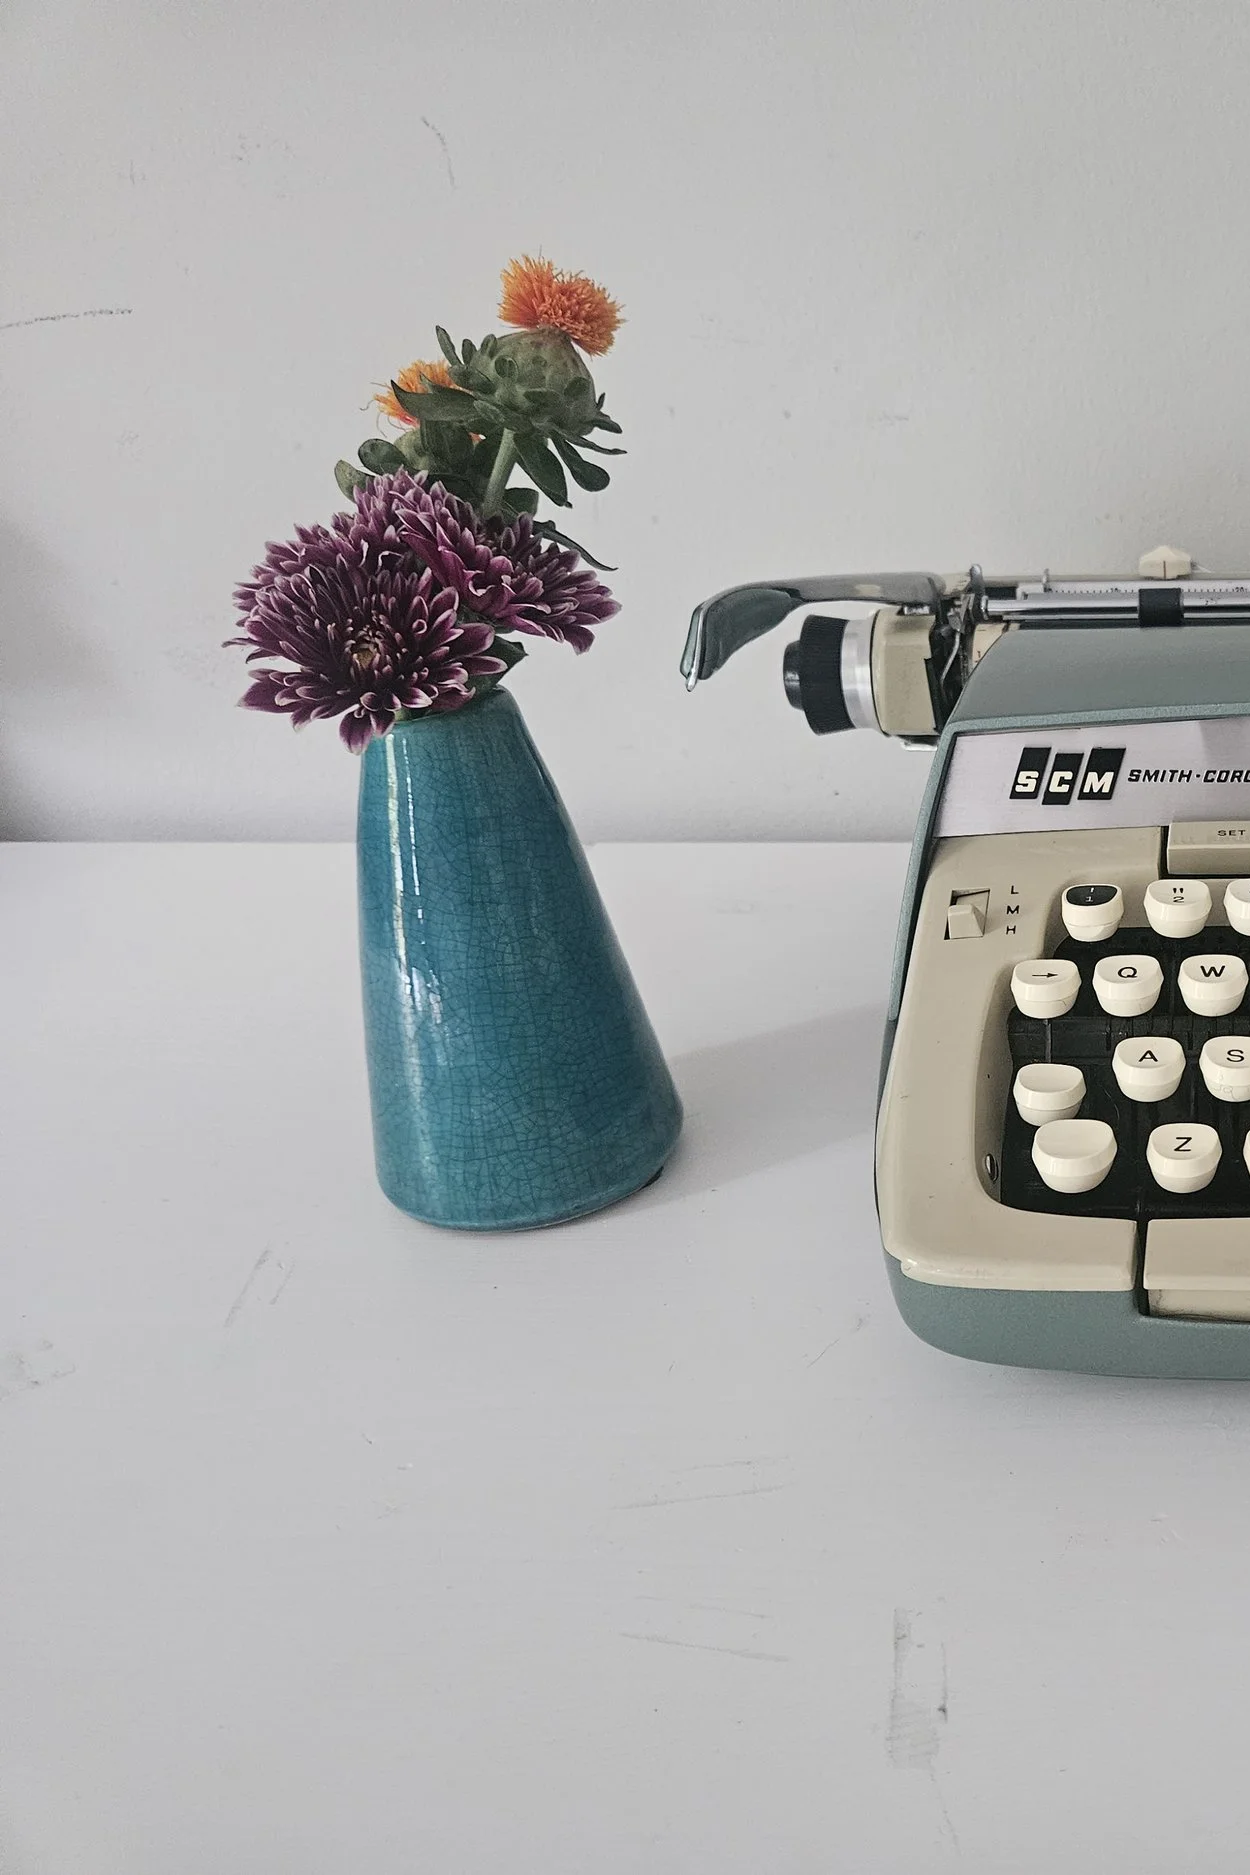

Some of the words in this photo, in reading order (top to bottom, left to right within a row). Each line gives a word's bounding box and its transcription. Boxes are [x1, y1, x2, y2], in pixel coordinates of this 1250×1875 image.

[1014, 770, 1114, 793] SCM
[1217, 829, 1246, 837] SET
[1010, 885, 1019, 895] L
[1172, 895, 1185, 903] 2
[1006, 904, 1020, 915] M
[1005, 925, 1017, 935] H
[1117, 966, 1138, 979] Q
[1199, 965, 1226, 978] W
[1138, 1049, 1159, 1063] A
[1226, 1049, 1245, 1063] S
[1173, 1136, 1193, 1152] Z
